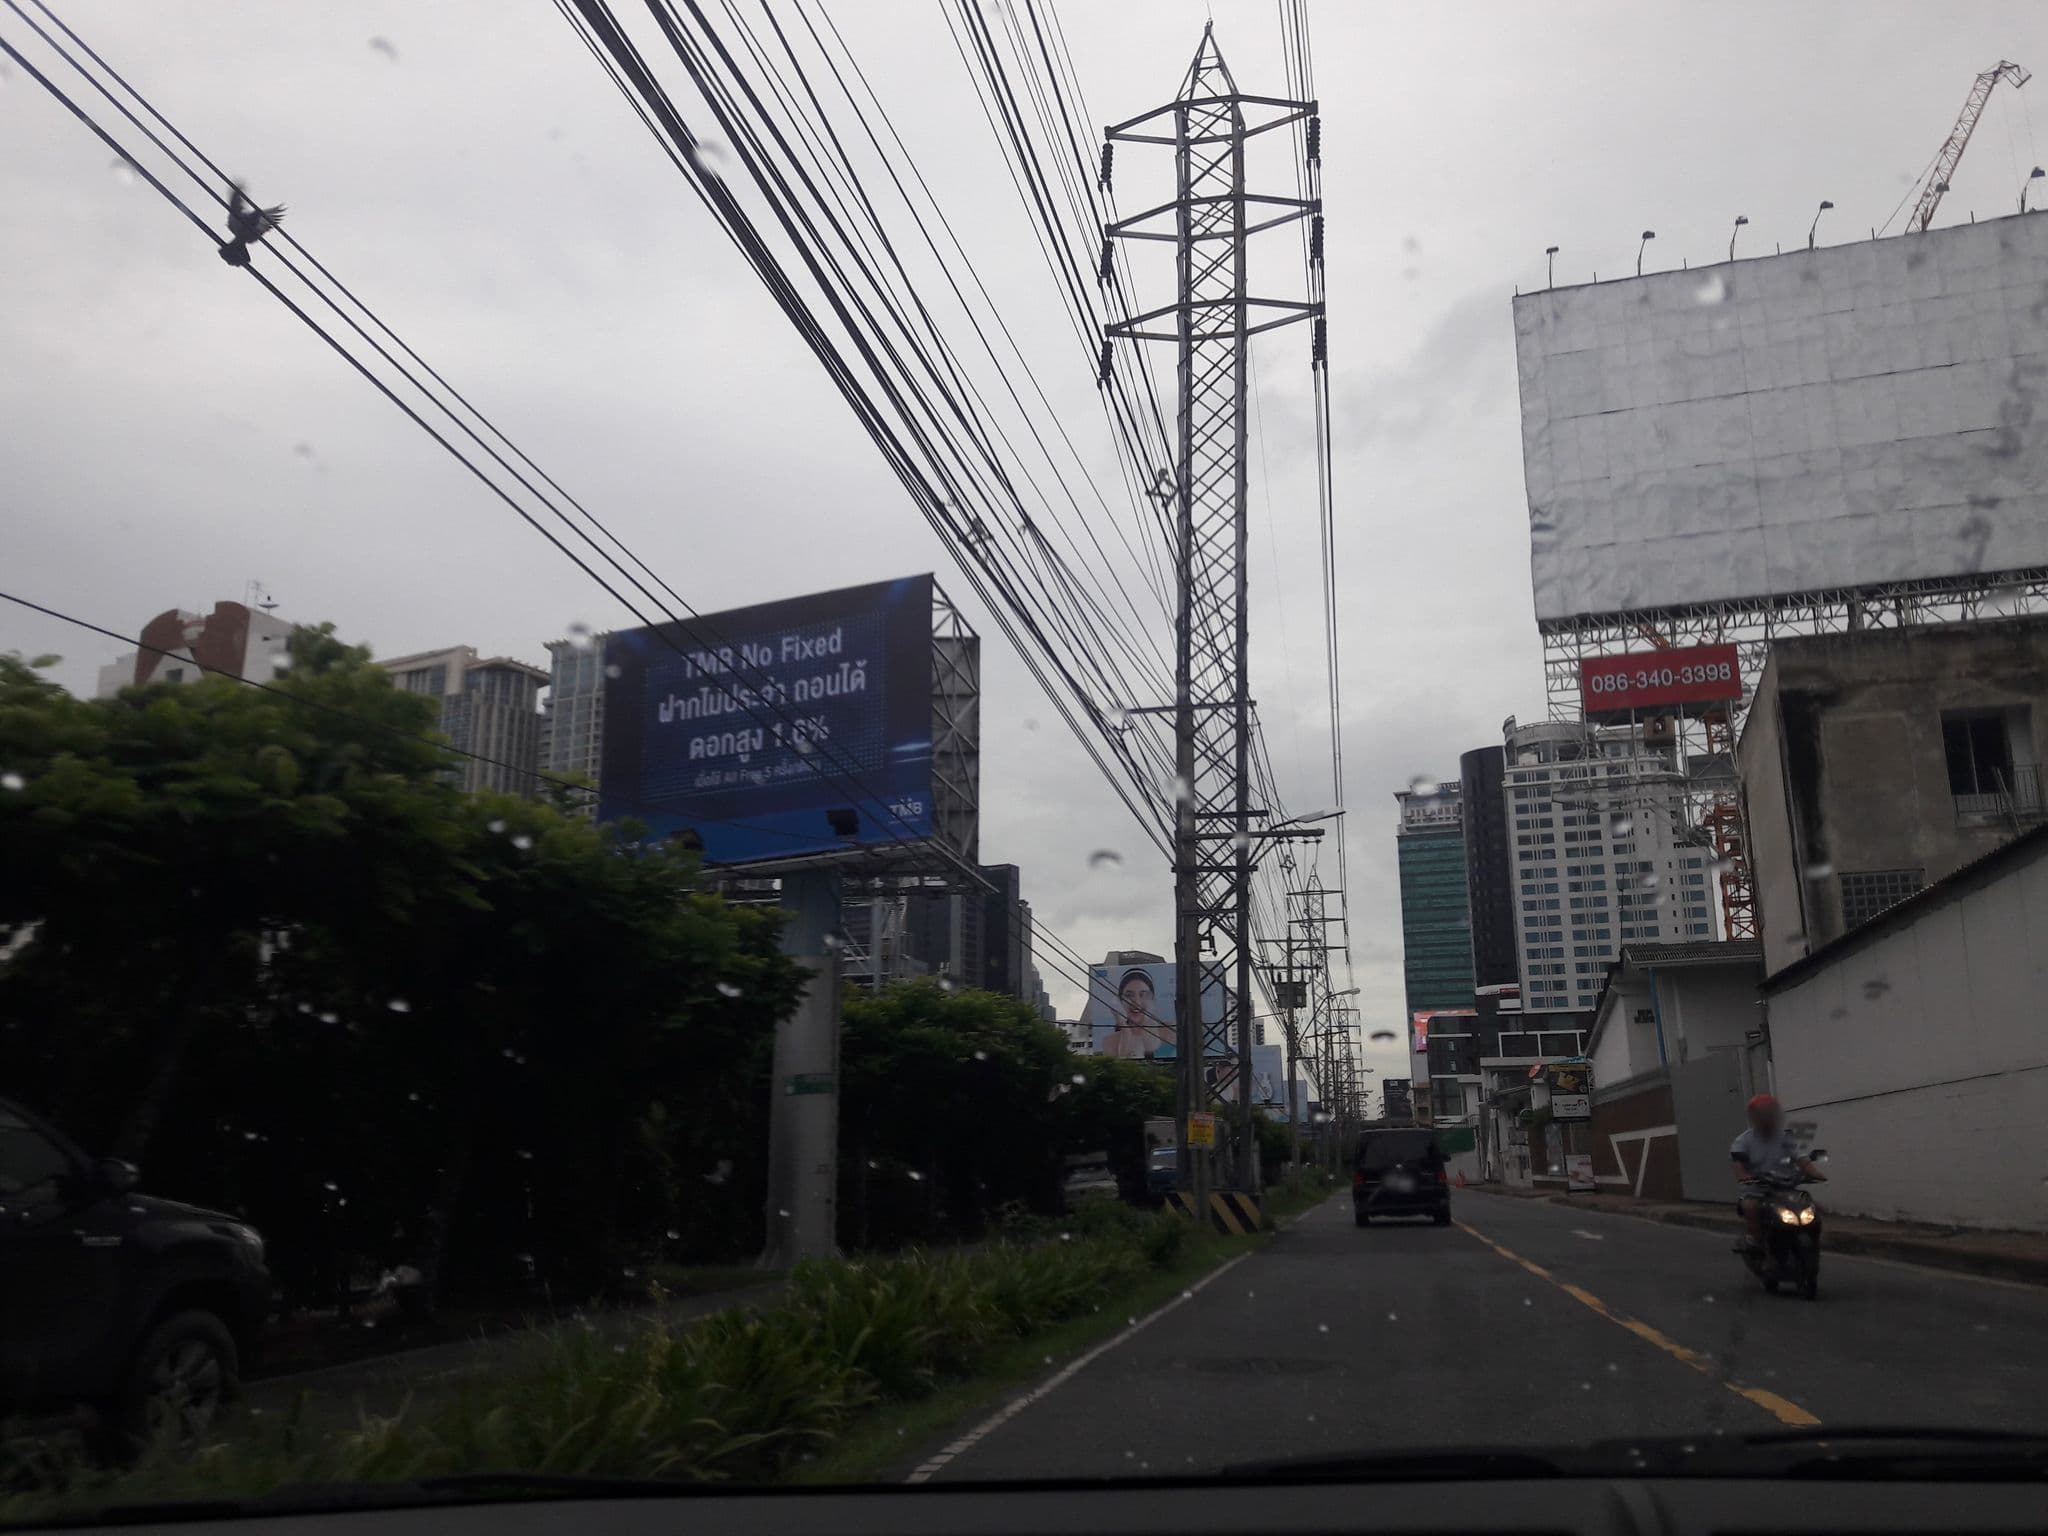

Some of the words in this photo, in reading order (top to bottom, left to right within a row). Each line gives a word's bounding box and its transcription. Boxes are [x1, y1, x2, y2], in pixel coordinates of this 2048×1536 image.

[683, 647, 733, 678] TMB
[740, 643, 772, 671] No
[782, 627, 841, 663] Fixed
[794, 659, 868, 702] ถอนได้
[1591, 662, 1732, 693] 086-340-3398
[888, 798, 923, 818] TMB
